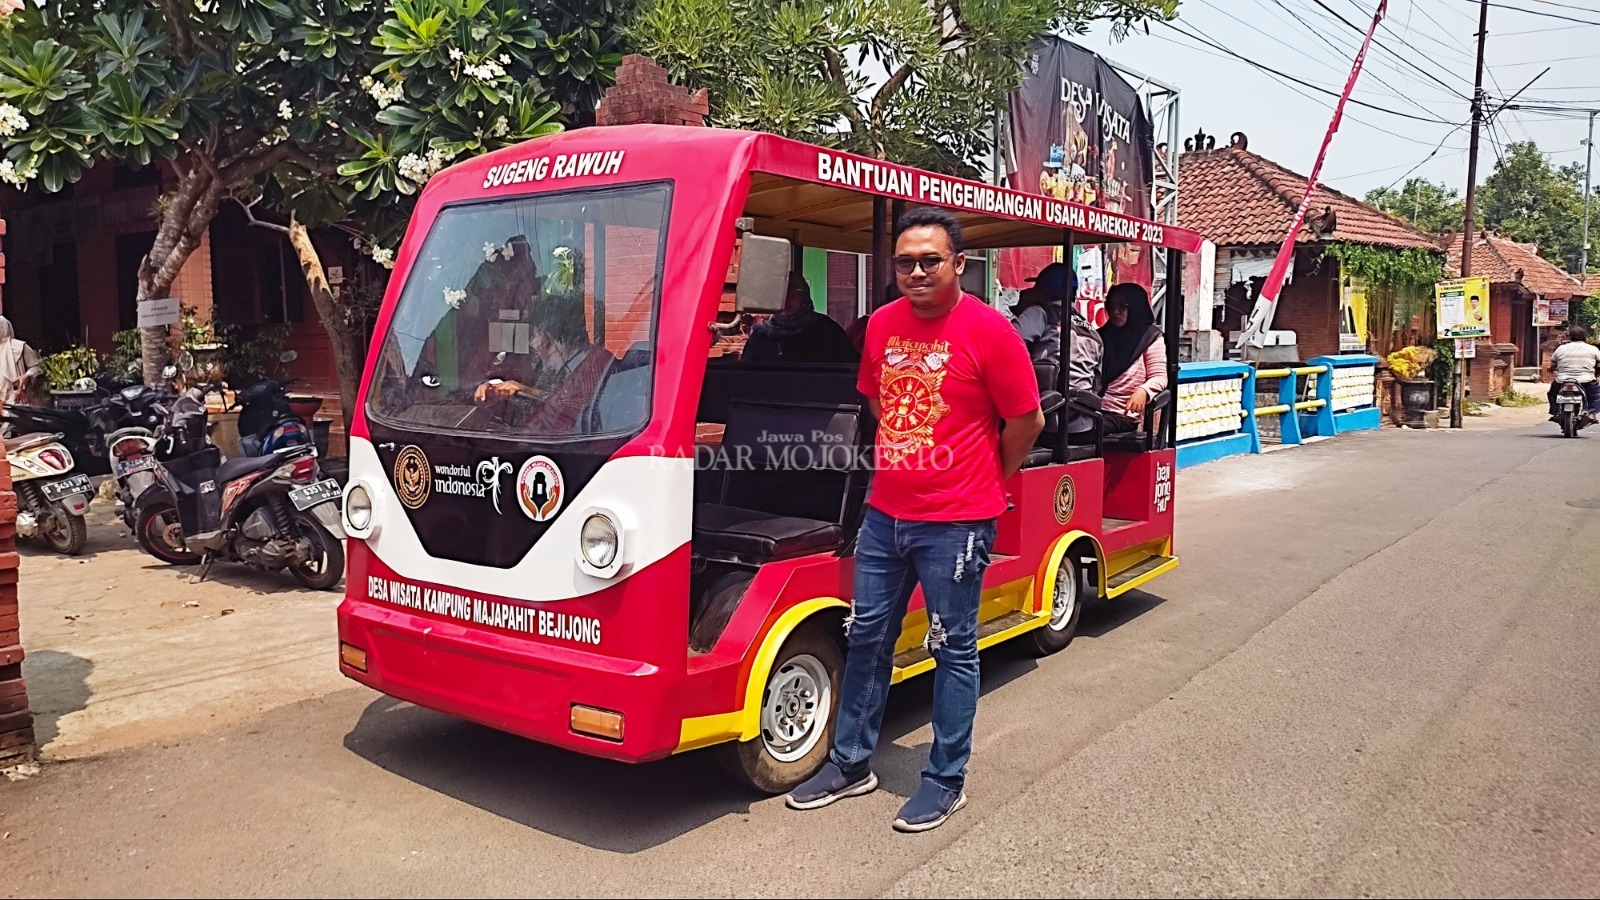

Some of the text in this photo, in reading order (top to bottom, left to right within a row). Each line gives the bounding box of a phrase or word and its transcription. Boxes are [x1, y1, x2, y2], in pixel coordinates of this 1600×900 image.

[1061, 76, 1093, 123] DESA
[483, 150, 625, 189] SUGENG RAWUH
[817, 152, 1163, 243] BANTUAN PENGEMBANGAN USAHA PAREKRAF 2023
[434, 464, 471, 477] wonderful
[434, 476, 486, 497] indonesia
[291, 492, 299, 500] S
[368, 575, 601, 645] DESA WISATA KAMPUNG MAJAPAHIT BEJIJONG
